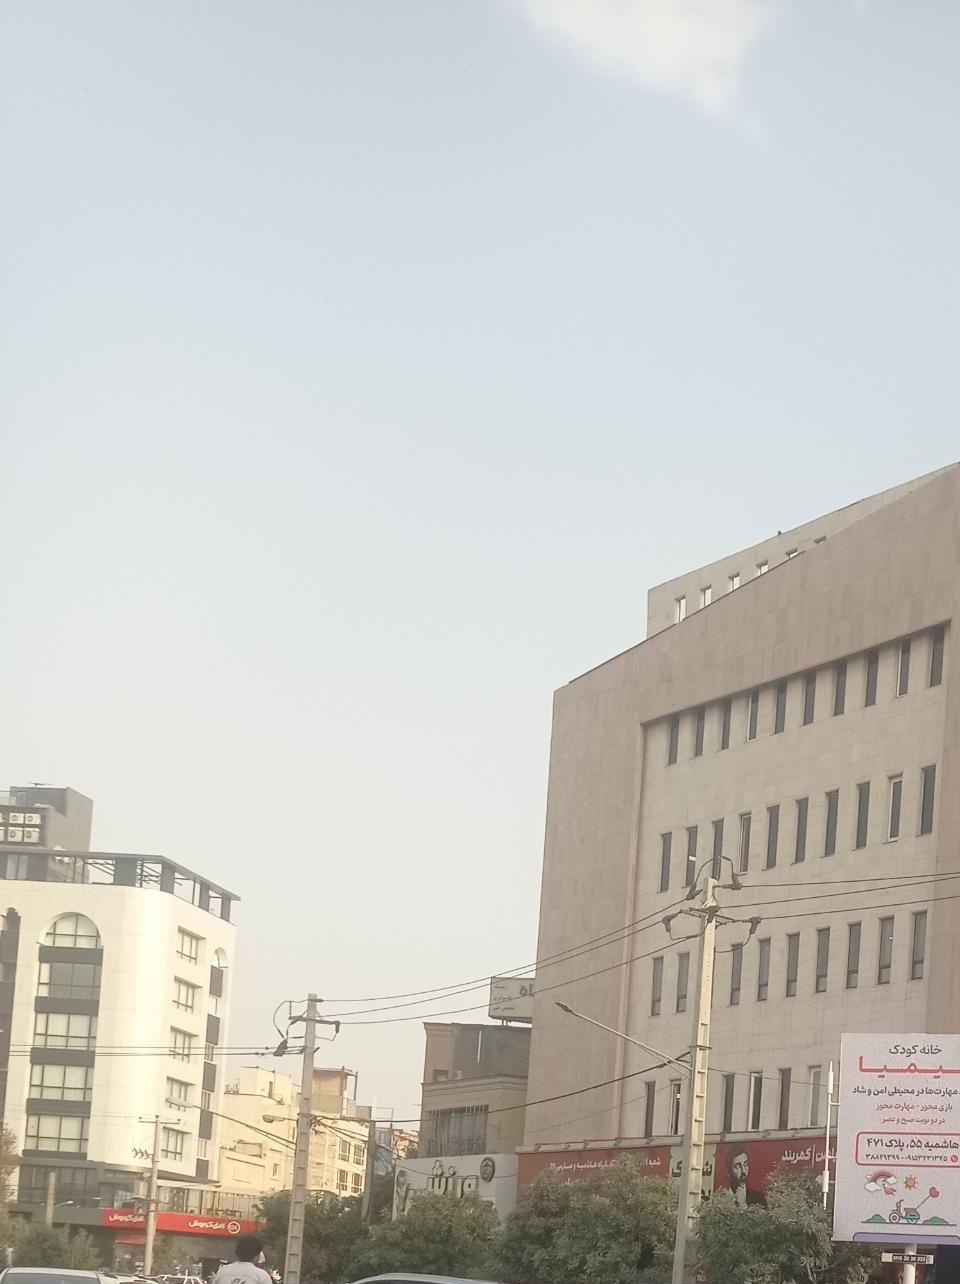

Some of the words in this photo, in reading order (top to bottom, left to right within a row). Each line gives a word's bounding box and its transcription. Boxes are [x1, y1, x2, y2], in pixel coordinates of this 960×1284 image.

[889, 1045, 919, 1057] کودک
[920, 1044, 942, 1055] خانه
[852, 1086, 867, 1094] شاد
[872, 1086, 887, 1096] امن
[888, 1086, 915, 1096] محیطی
[916, 1088, 925, 1097] در
[866, 1138, 884, 1148] ۴۷۱
[885, 1138, 905, 1152] پلاک
[924, 1140, 960, 1151] هاشمیه
